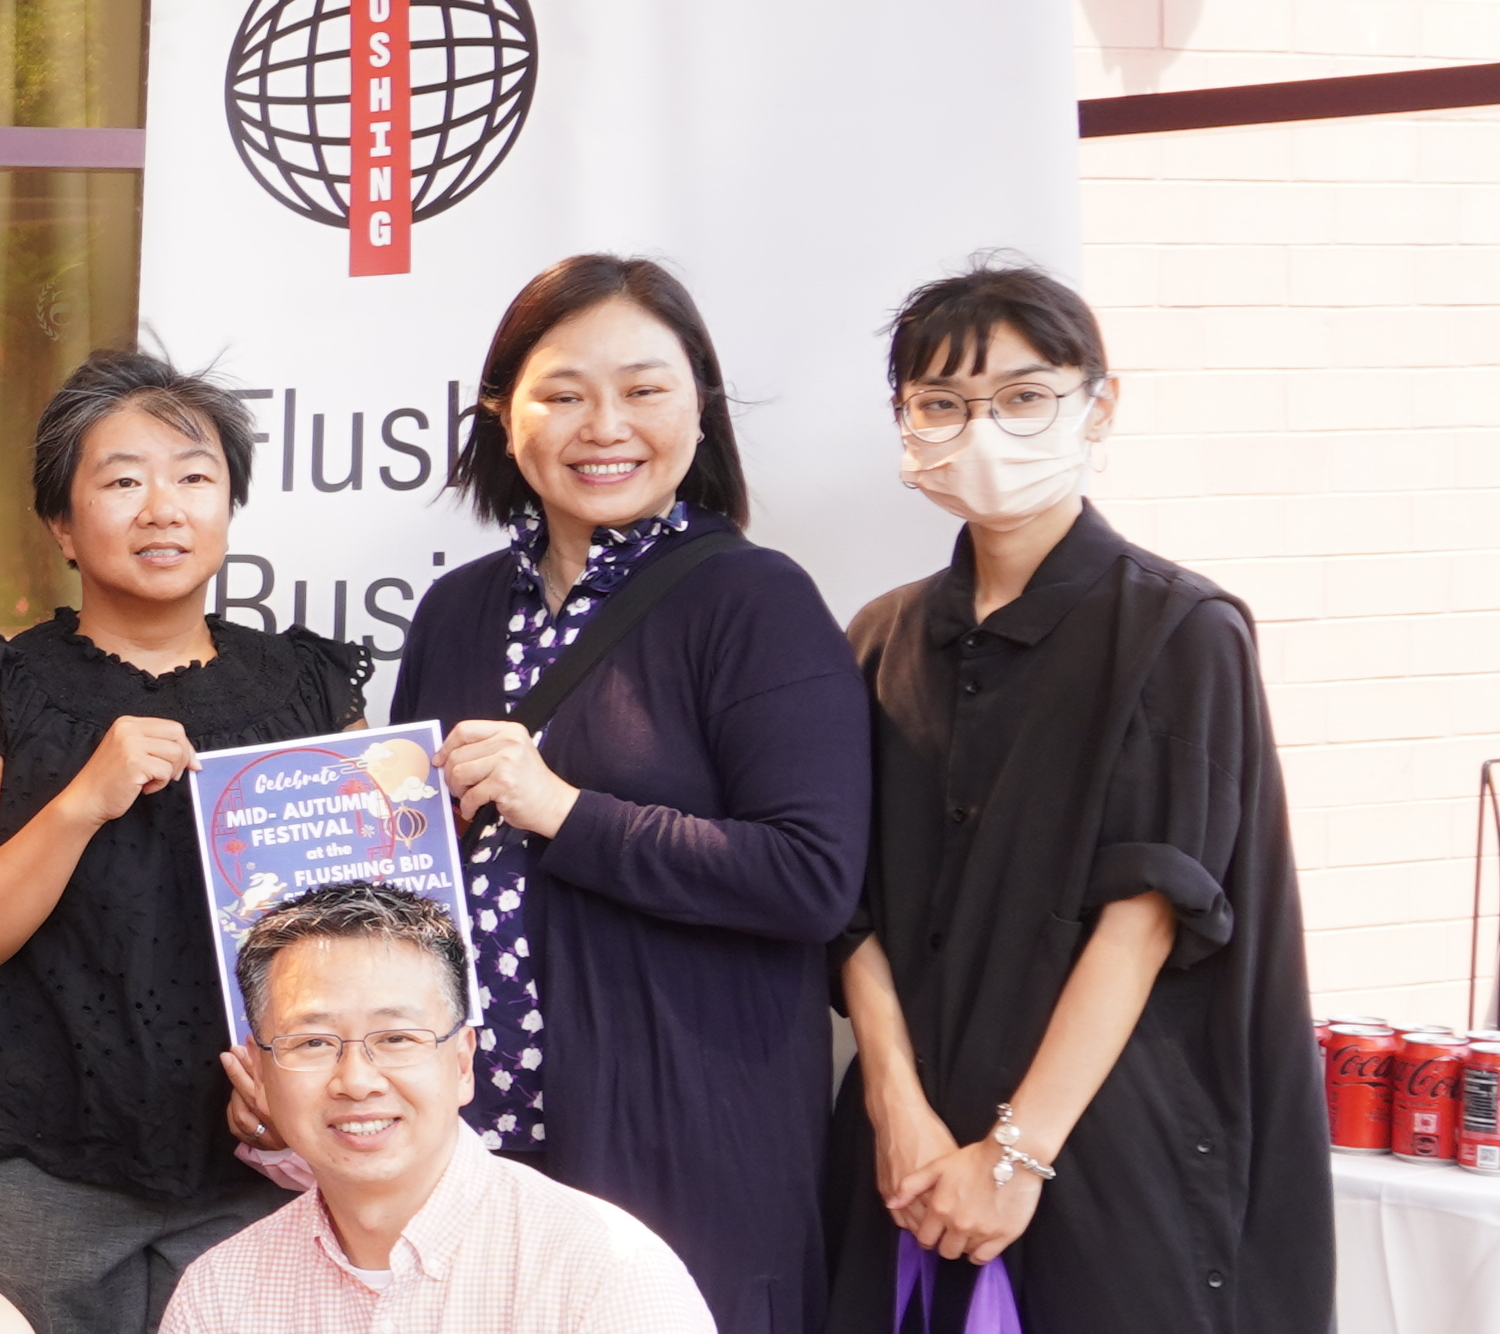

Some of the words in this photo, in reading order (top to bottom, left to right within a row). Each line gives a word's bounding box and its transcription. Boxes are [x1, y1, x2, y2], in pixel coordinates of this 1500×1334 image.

[254, 767, 341, 794] Celebrate
[282, 790, 376, 821] AUTUMN
[251, 818, 354, 847] FESTIVAL
[306, 847, 324, 861] at
[325, 842, 353, 858] the
[294, 858, 396, 888] FLUSHING
[400, 853, 434, 874] BID
